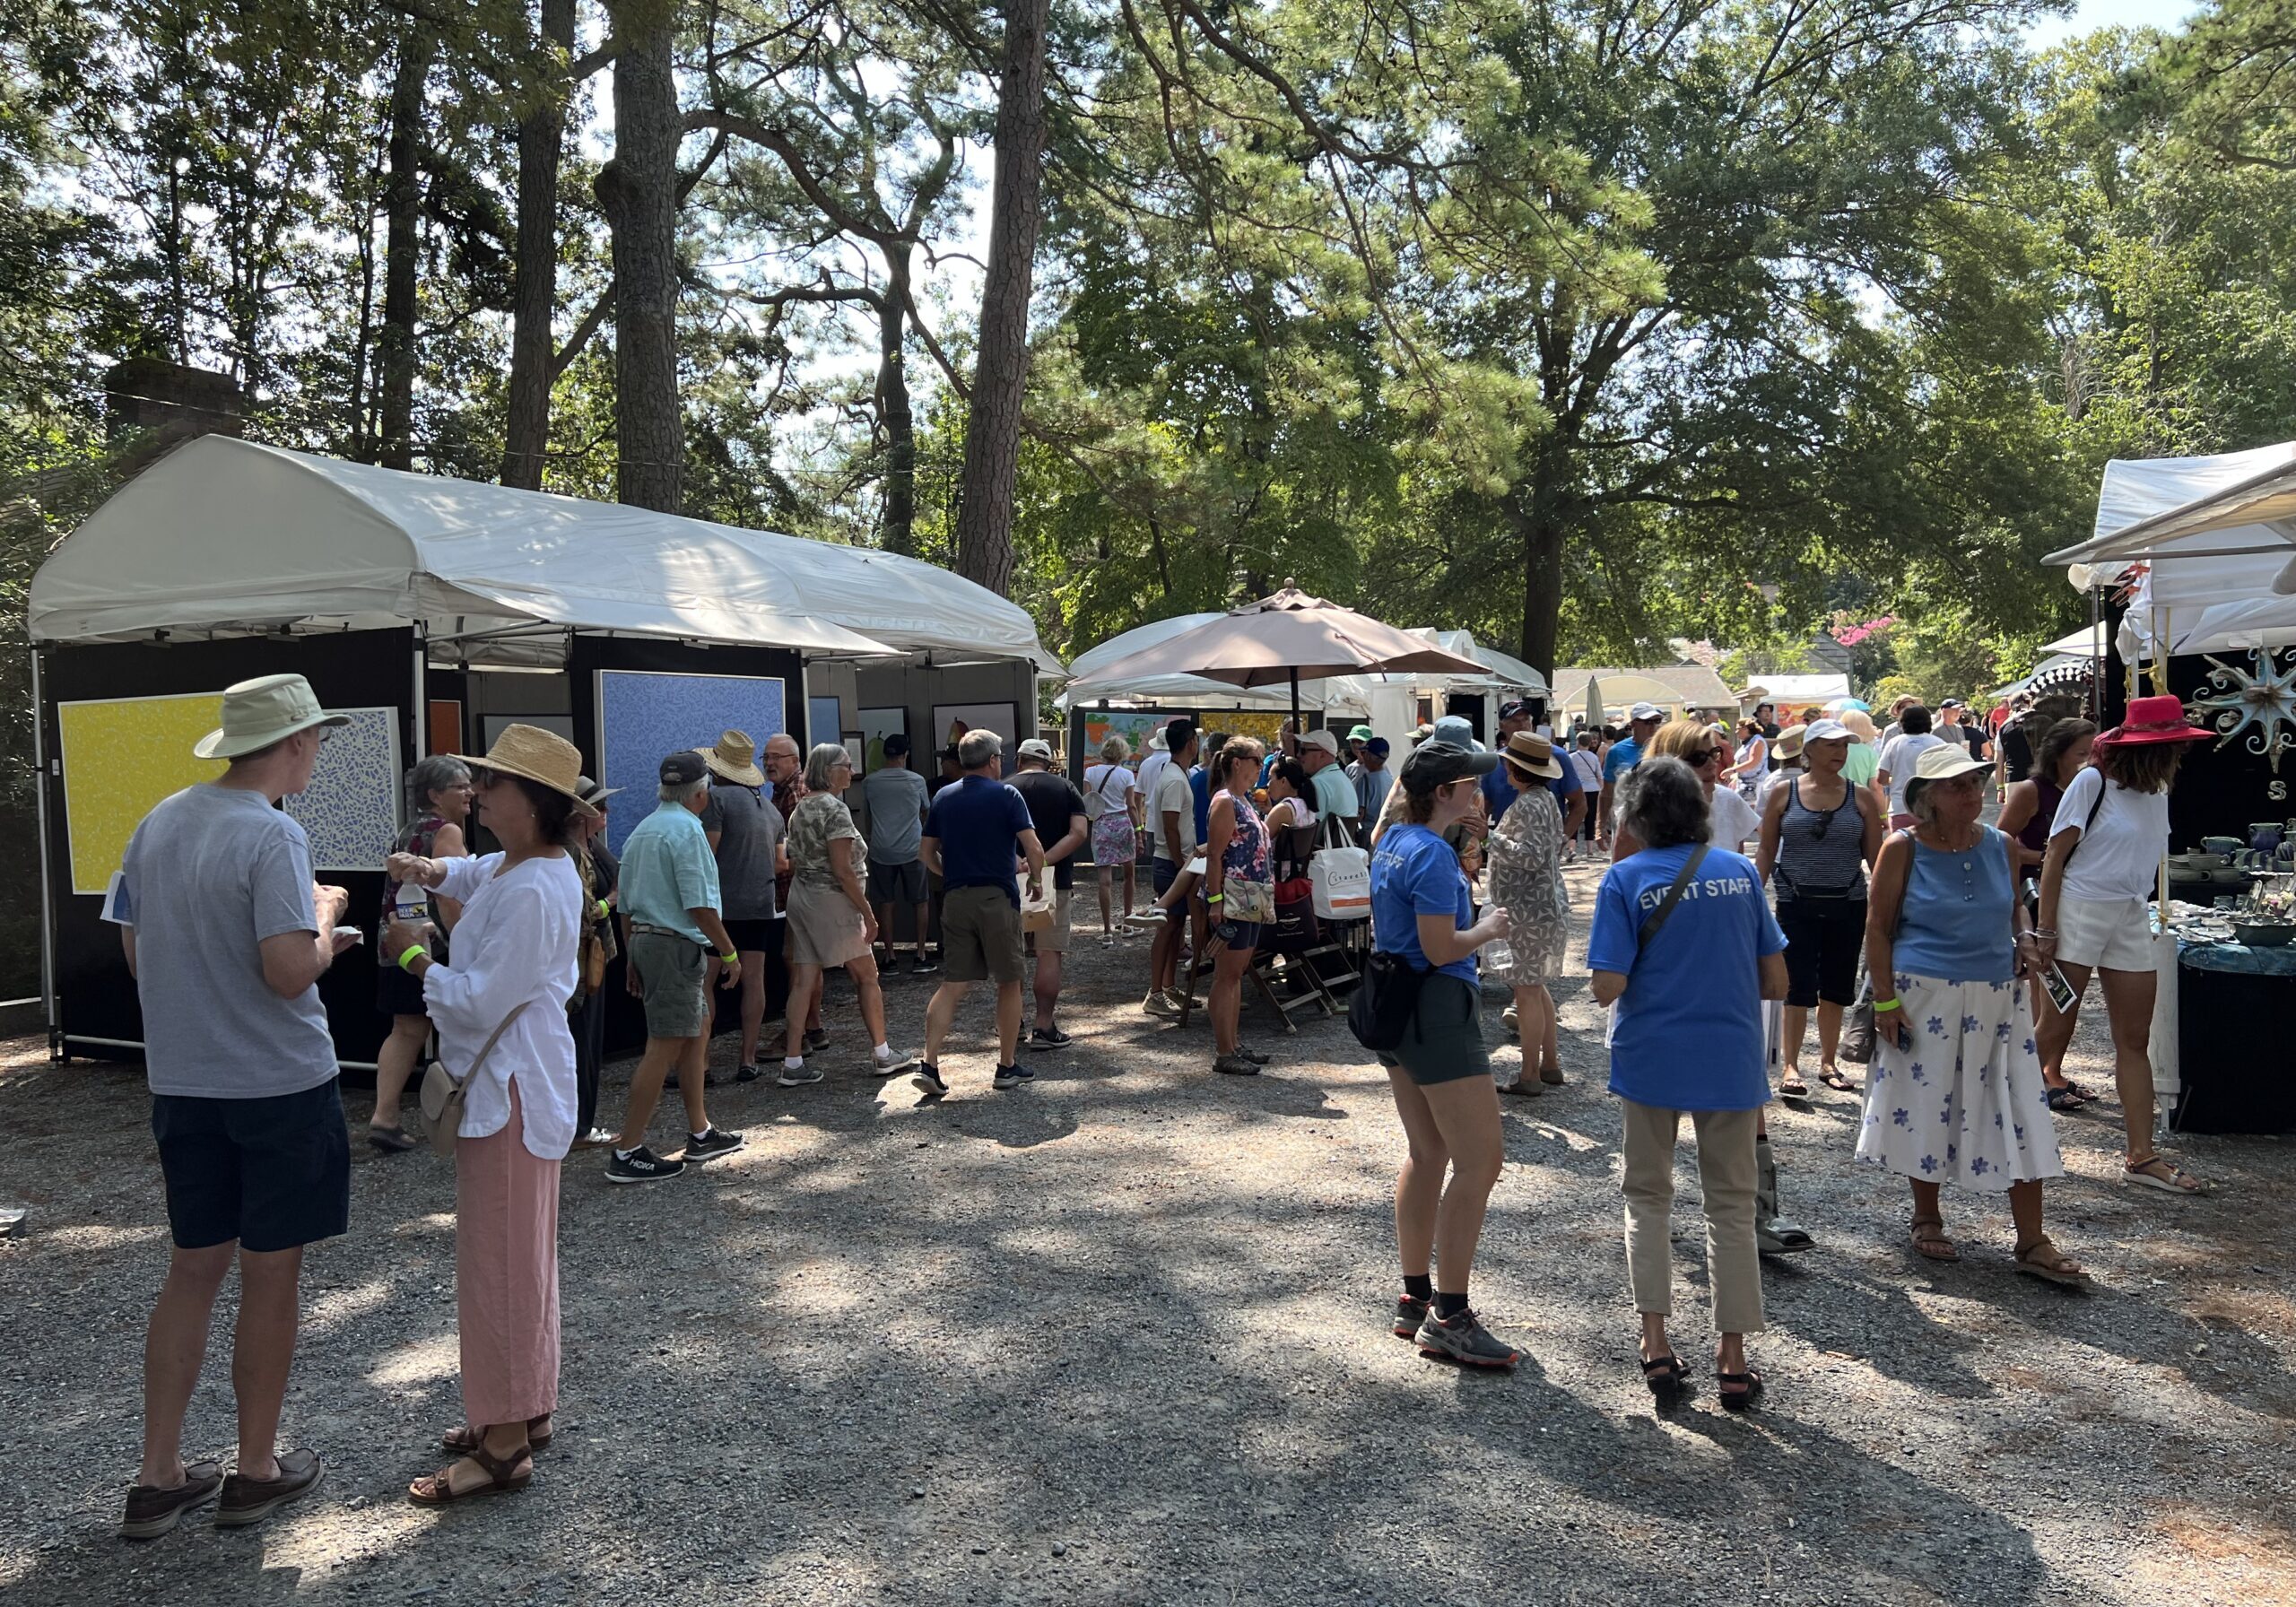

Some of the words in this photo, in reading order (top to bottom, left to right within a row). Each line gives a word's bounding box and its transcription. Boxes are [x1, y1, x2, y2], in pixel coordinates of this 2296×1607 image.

[2267, 780, 2287, 801] S
[1705, 877, 1752, 897] STAFF
[629, 1158, 656, 1171] HOKA
